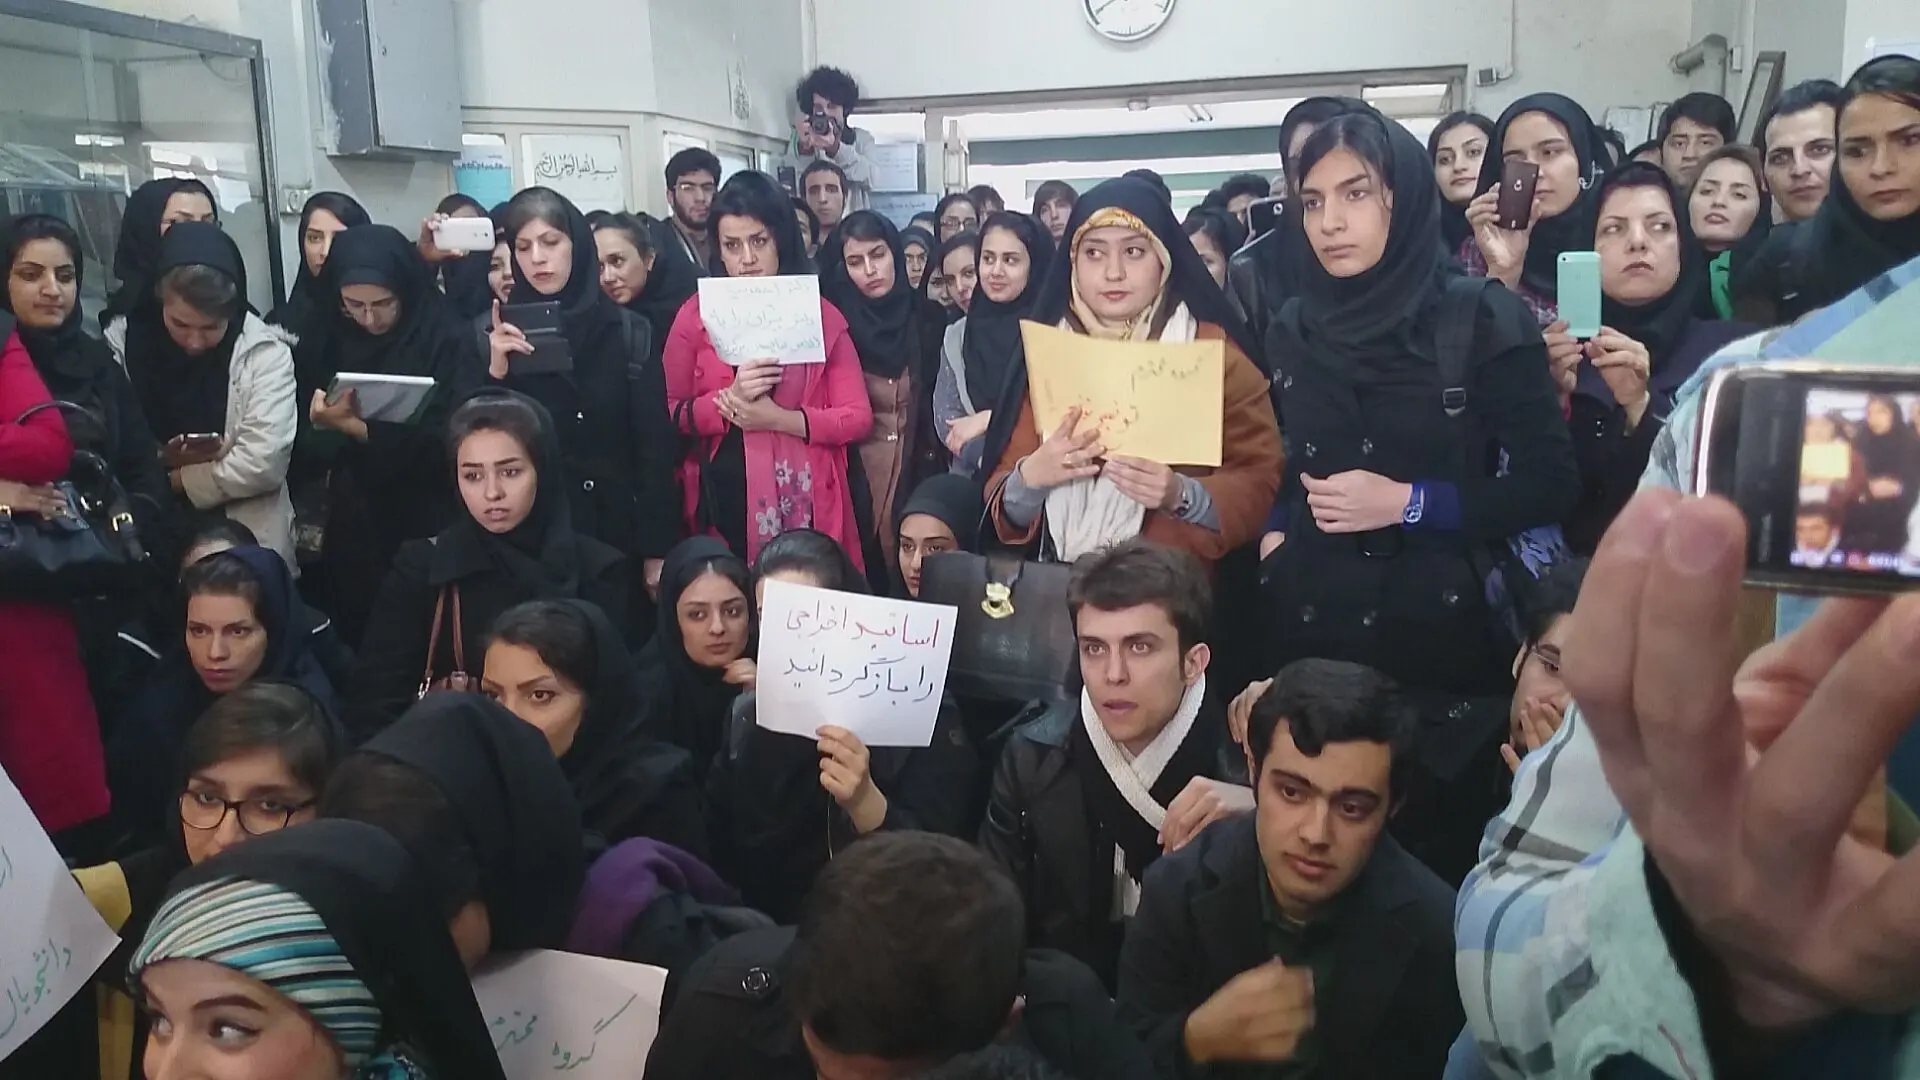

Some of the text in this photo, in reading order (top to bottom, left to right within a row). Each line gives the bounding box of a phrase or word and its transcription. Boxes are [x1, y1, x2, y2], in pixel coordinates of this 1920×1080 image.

[787, 600, 939, 650] اساتید اخراجی
[912, 665, 934, 702] را
[553, 993, 638, 1070] گروه
